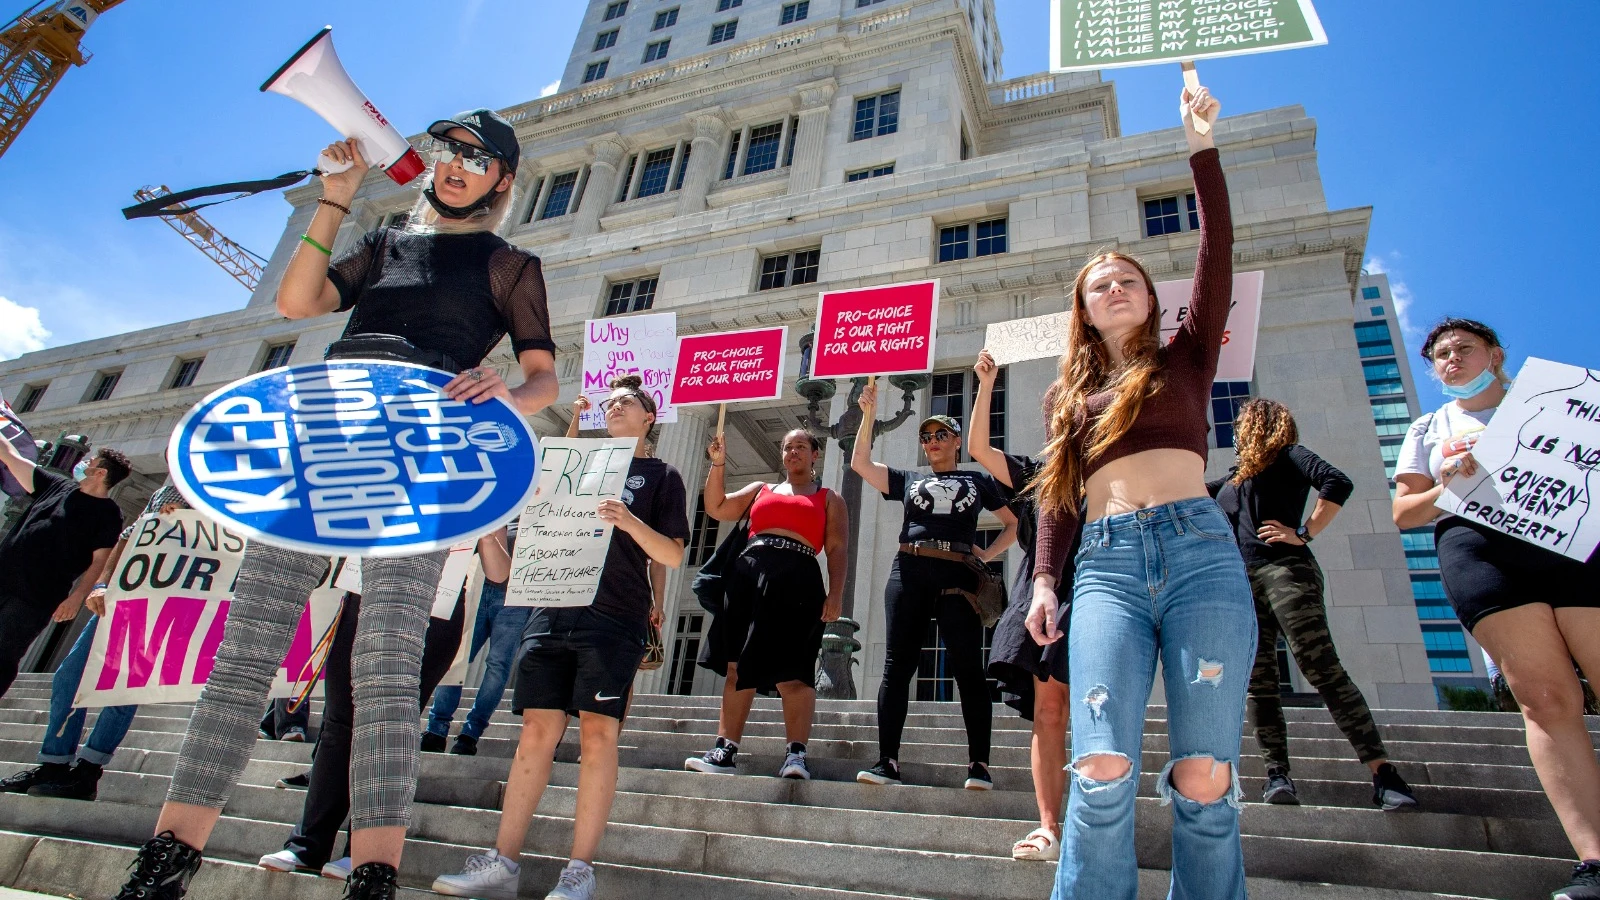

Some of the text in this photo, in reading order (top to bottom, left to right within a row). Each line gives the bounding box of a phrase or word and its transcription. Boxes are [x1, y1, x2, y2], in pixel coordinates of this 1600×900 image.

[1075, 20, 1080, 29] I
[1087, 13, 1152, 27] VALUE
[1160, 9, 1187, 20] MY
[1079, 11, 1084, 19] I
[1091, 4, 1152, 17] VALUE
[1158, 0, 1184, 10] MY
[1074, 18, 1284, 49] I VALUE MY CHOICE.
[1089, 23, 1152, 37] VALUE
[1158, 19, 1185, 30] MY
[1192, 8, 1272, 25] HEALTH
[1076, 29, 1278, 60] I VALUE MY HEALTH
[836, 305, 913, 324] PRO-CHOICE
[590, 322, 629, 346] Why
[834, 320, 914, 340] IS OUR FIGHT
[693, 346, 764, 361] PRO-CHOICE
[823, 335, 924, 357] FOR OUR RIGHTS
[606, 350, 634, 369] gun
[690, 358, 764, 374] IS OUR FIGHT
[680, 370, 773, 388] FOR OUR RIGHTS
[190, 396, 301, 514] KEEP
[286, 369, 421, 539] ABORTION
[381, 379, 498, 516] LEGAL
[1529, 435, 1560, 455] IS
[541, 446, 632, 496] FREE
[538, 501, 597, 519] Childcare
[1506, 488, 1568, 520] MENT
[575, 528, 591, 538] Care
[1463, 500, 1568, 546] PROPERTY
[135, 517, 245, 553] BANS
[118, 553, 222, 592] OUR
